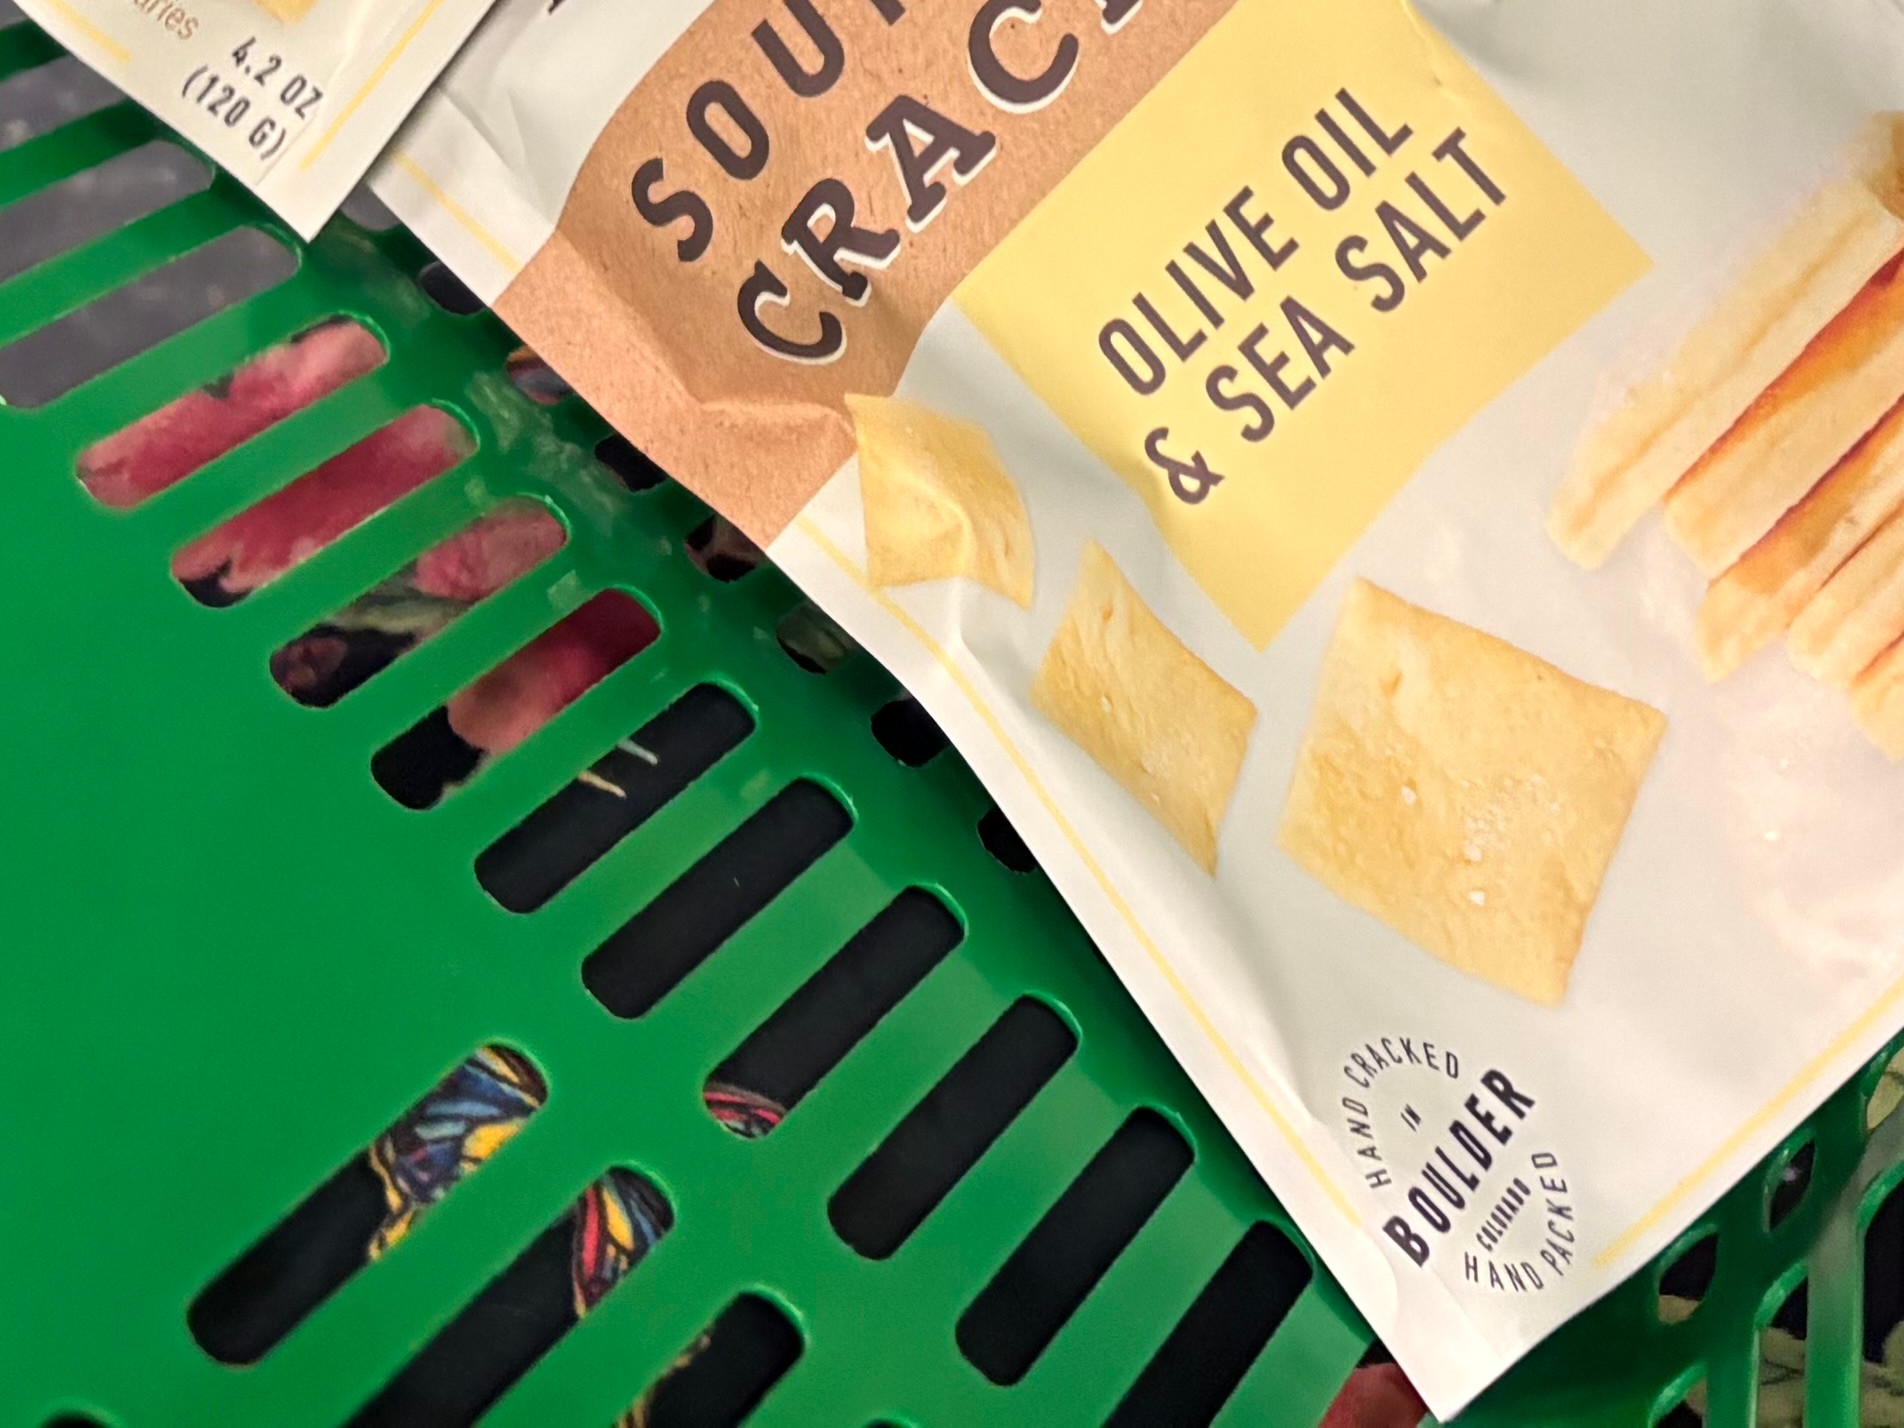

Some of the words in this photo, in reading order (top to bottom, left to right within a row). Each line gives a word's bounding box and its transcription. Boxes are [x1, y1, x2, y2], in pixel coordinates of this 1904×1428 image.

[182, 66, 250, 126] (120
[249, 118, 286, 159] G)
[232, 37, 281, 86] 4.2
[280, 75, 322, 119] OZ
[1099, 186, 1299, 395] OLIVE
[1282, 88, 1413, 210] OIL
[1145, 427, 1224, 504] &
[1206, 304, 1355, 442] SEA
[1335, 127, 1505, 312] SALT
[1344, 1037, 1458, 1088] CRACKED
[1343, 1097, 1391, 1188] HAND
[1401, 1105, 1421, 1131] IN
[1383, 1070, 1534, 1267] BOULDER
[1477, 1178, 1530, 1251] COLORADO
[1465, 1252, 1544, 1292] HAND
[1531, 1153, 1574, 1276] PACKED
